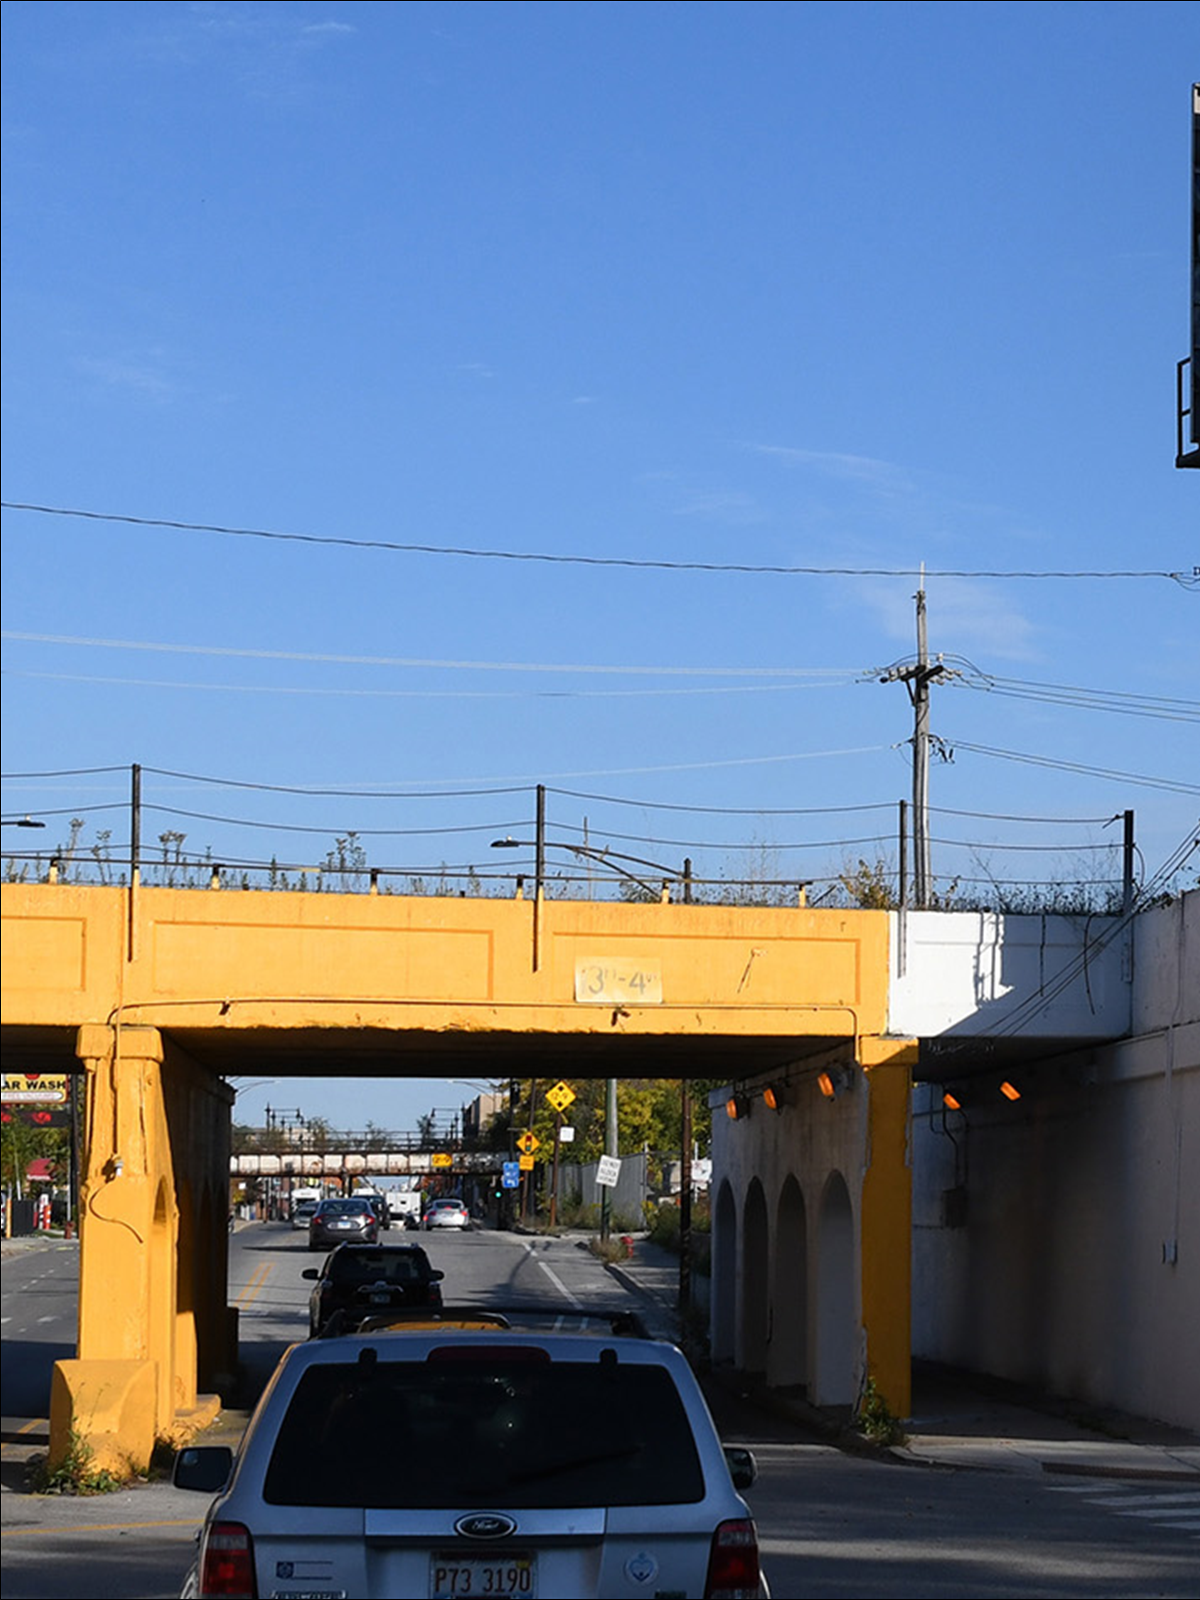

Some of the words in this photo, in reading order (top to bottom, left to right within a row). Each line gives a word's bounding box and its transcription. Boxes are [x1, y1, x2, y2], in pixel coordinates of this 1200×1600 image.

[26, 1081, 66, 1090] WASH
[434, 1567, 472, 1593] P73
[482, 1567, 532, 1593] 3190
